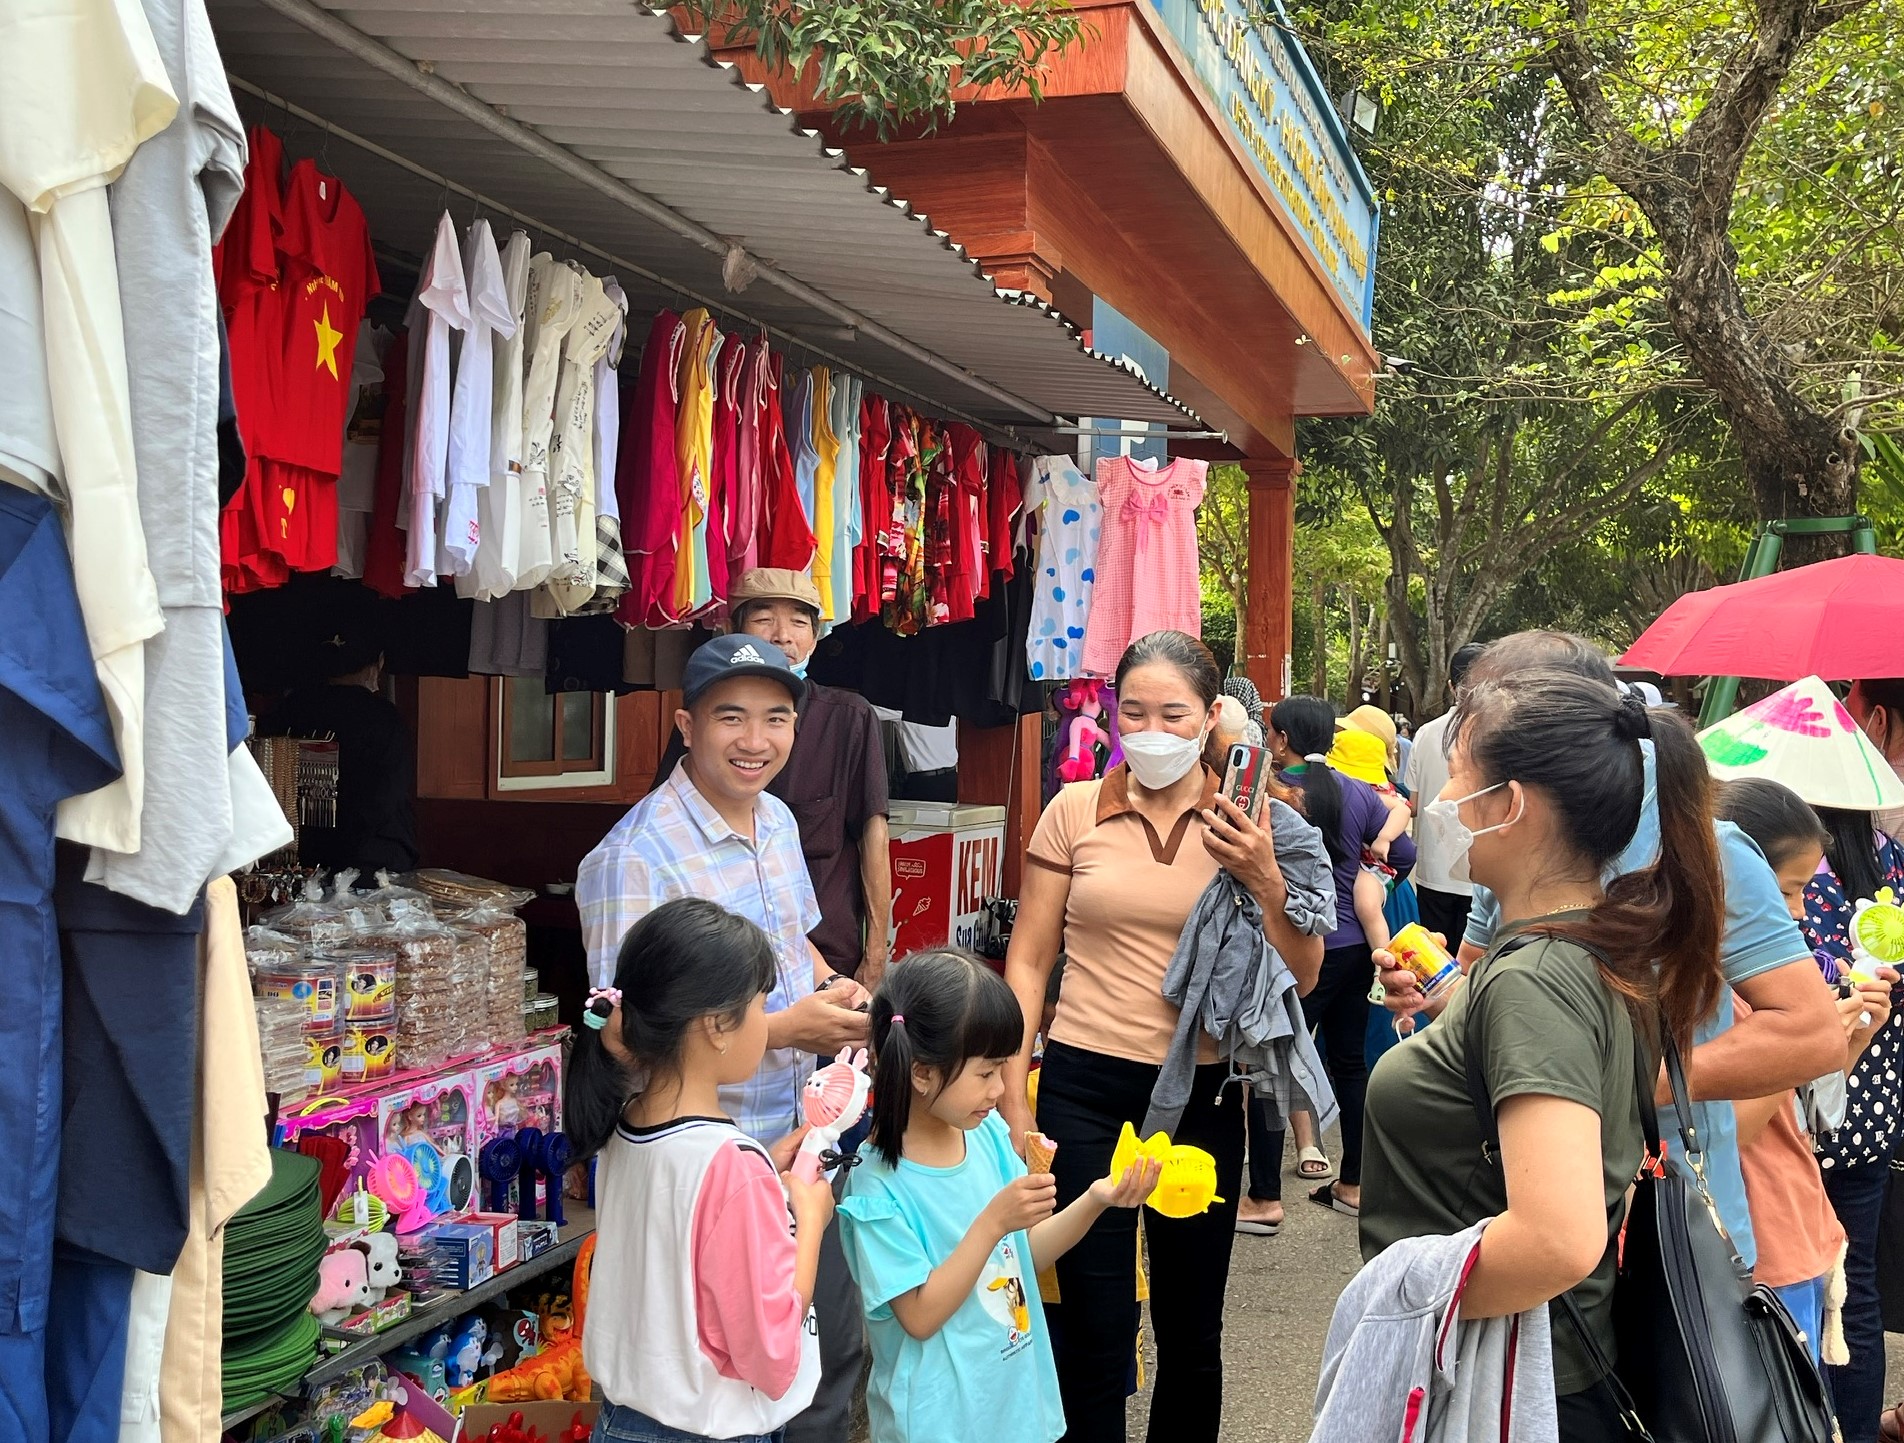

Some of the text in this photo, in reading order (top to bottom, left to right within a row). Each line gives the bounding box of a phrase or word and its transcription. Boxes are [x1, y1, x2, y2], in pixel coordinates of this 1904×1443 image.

[730, 654, 766, 664] adidas
[1236, 784, 1255, 794] GUCCI
[957, 837, 998, 917] KEM
